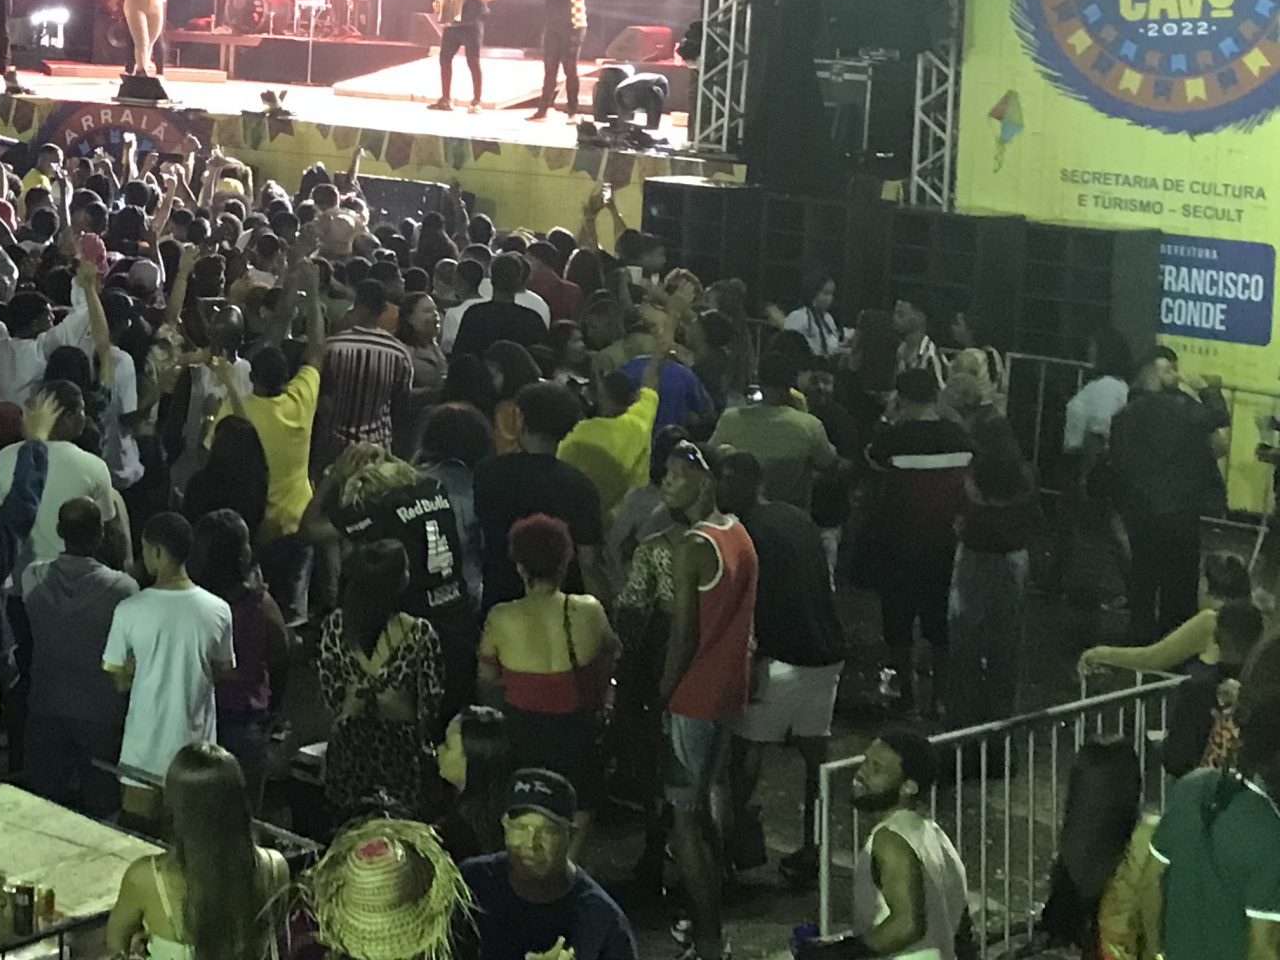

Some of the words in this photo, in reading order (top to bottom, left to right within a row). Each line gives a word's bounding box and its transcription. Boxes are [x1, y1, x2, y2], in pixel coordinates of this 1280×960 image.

[1147, 21, 1209, 37] 2022
[1060, 168, 1159, 191] SECRETARIA
[1163, 178, 1185, 194] DE
[1189, 181, 1266, 201] CULTURA
[1077, 194, 1088, 207] E
[1093, 195, 1164, 215] TURISMO
[1181, 204, 1245, 223] SECULT
[1160, 297, 1228, 331] CONDE
